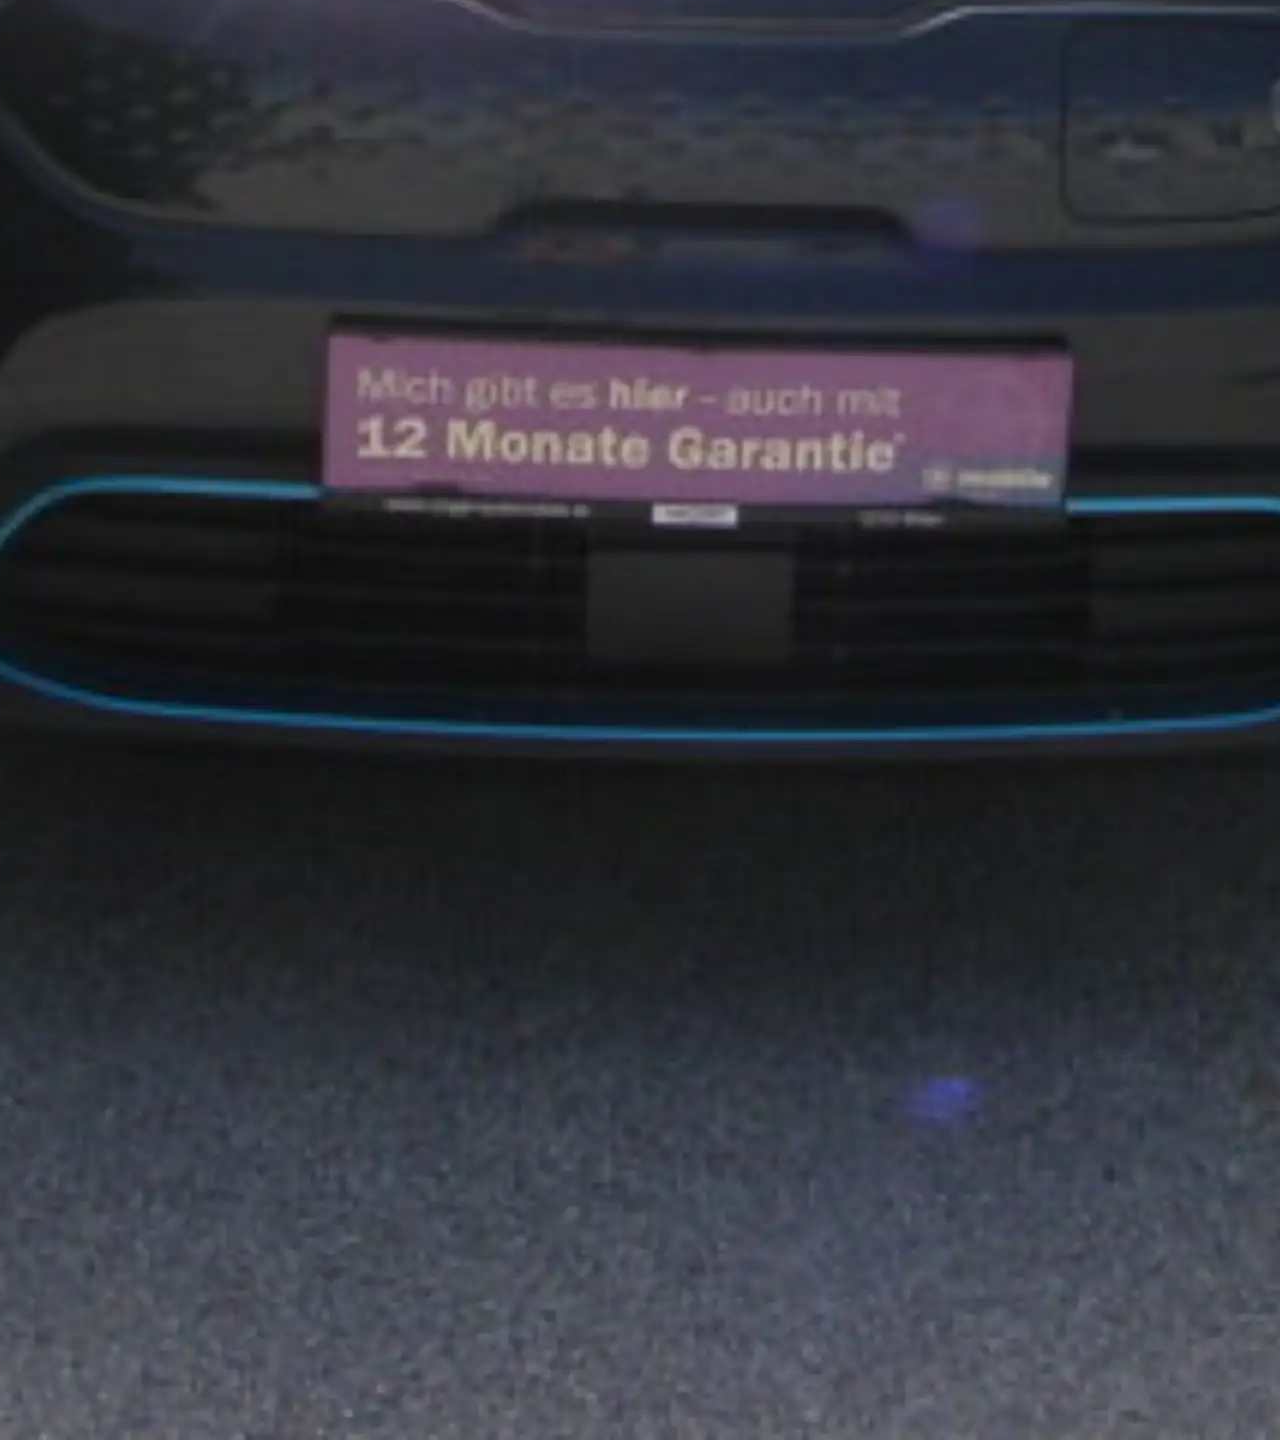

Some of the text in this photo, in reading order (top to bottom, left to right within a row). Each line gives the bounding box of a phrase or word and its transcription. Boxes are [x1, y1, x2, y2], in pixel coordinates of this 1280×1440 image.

[357, 368, 453, 405] Mich
[465, 374, 538, 414] gibt
[548, 381, 596, 409] es
[608, 377, 687, 412] hier
[728, 384, 822, 417] auch
[836, 386, 901, 420] mit
[356, 416, 428, 459] 12
[446, 417, 649, 469] Monate
